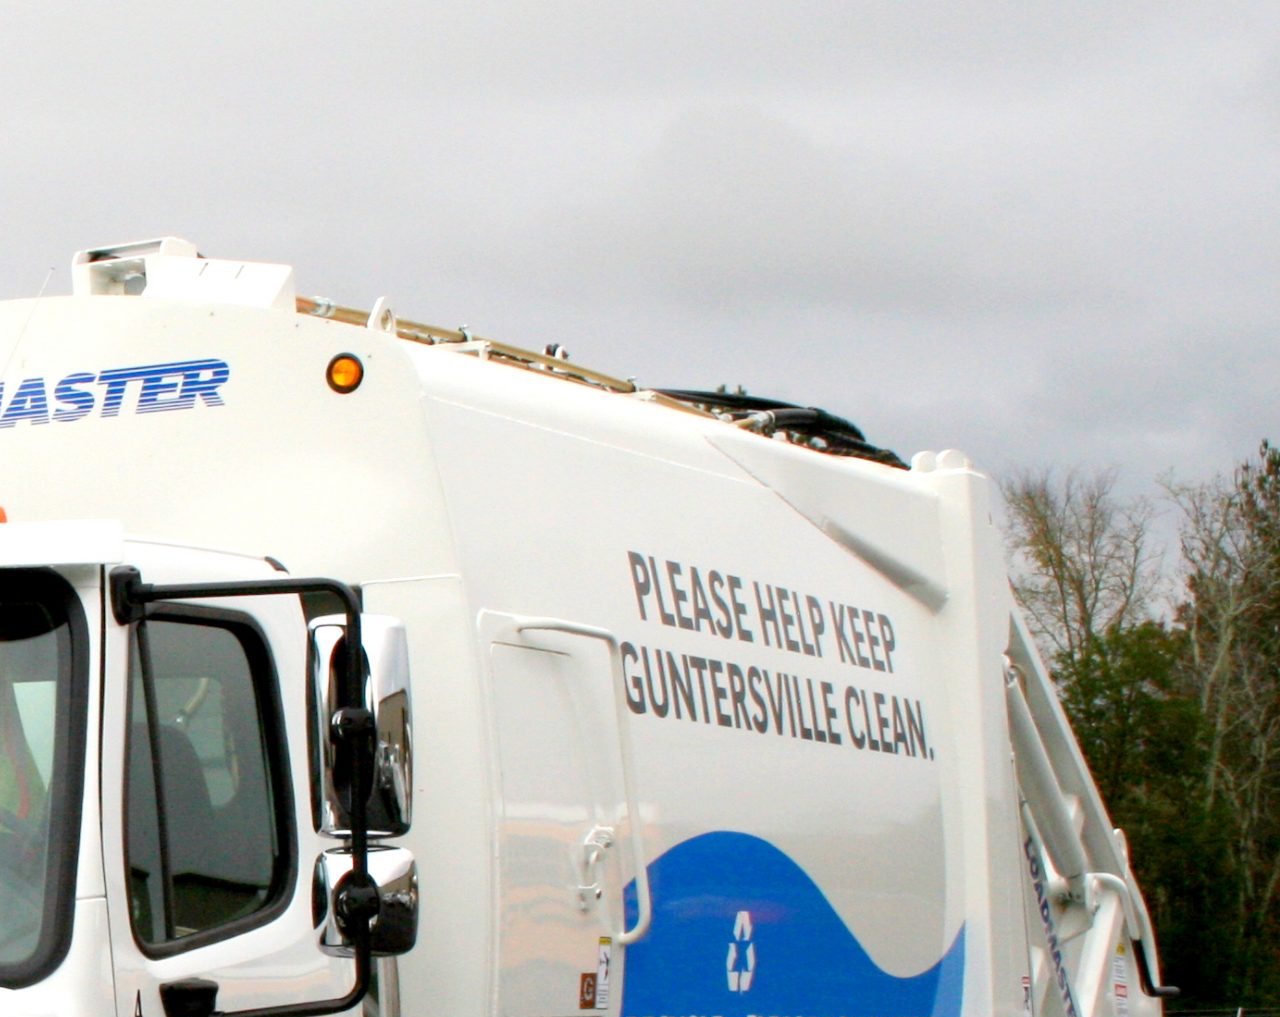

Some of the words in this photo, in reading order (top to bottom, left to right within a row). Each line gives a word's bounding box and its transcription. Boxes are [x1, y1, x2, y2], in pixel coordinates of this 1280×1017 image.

[627, 550, 754, 643] PLEASE
[752, 580, 825, 658] HELP
[828, 600, 897, 674] KEEP
[621, 641, 842, 745] GUNTERSVILLE
[844, 686, 936, 762] CLEAN.
